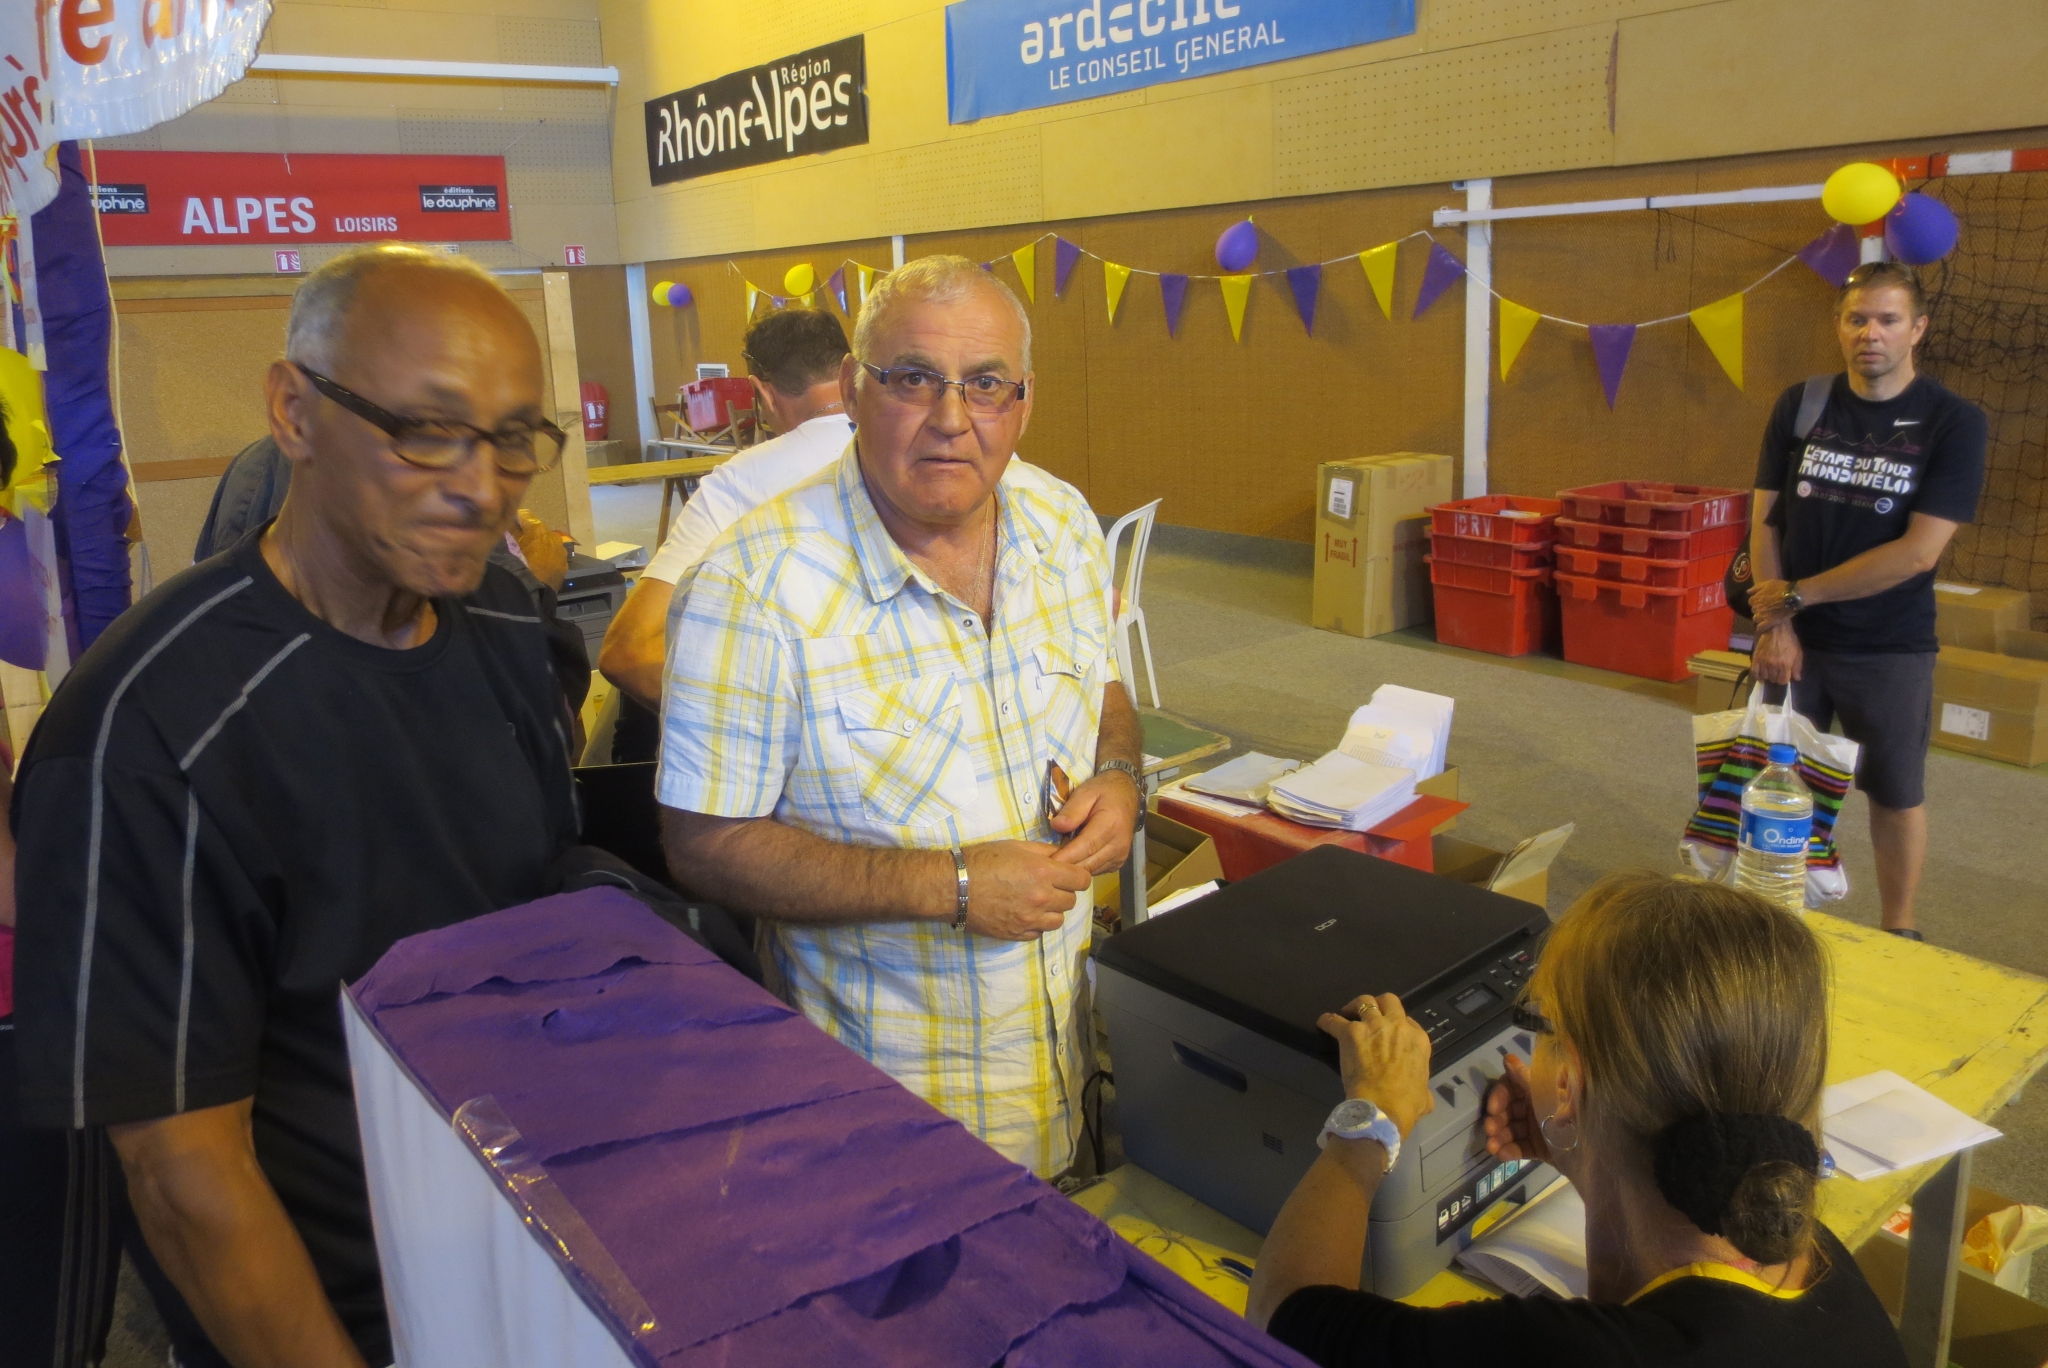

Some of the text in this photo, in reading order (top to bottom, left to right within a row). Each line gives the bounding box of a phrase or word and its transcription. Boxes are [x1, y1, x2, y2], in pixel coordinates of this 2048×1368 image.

[1050, 20, 1285, 90] LE CONSEIL GENERAL
[781, 58, 831, 85] Région
[422, 195, 434, 208] le
[183, 197, 316, 234] ALPES
[335, 216, 398, 232] LOISIRS
[1763, 828, 1806, 846] Ondine
